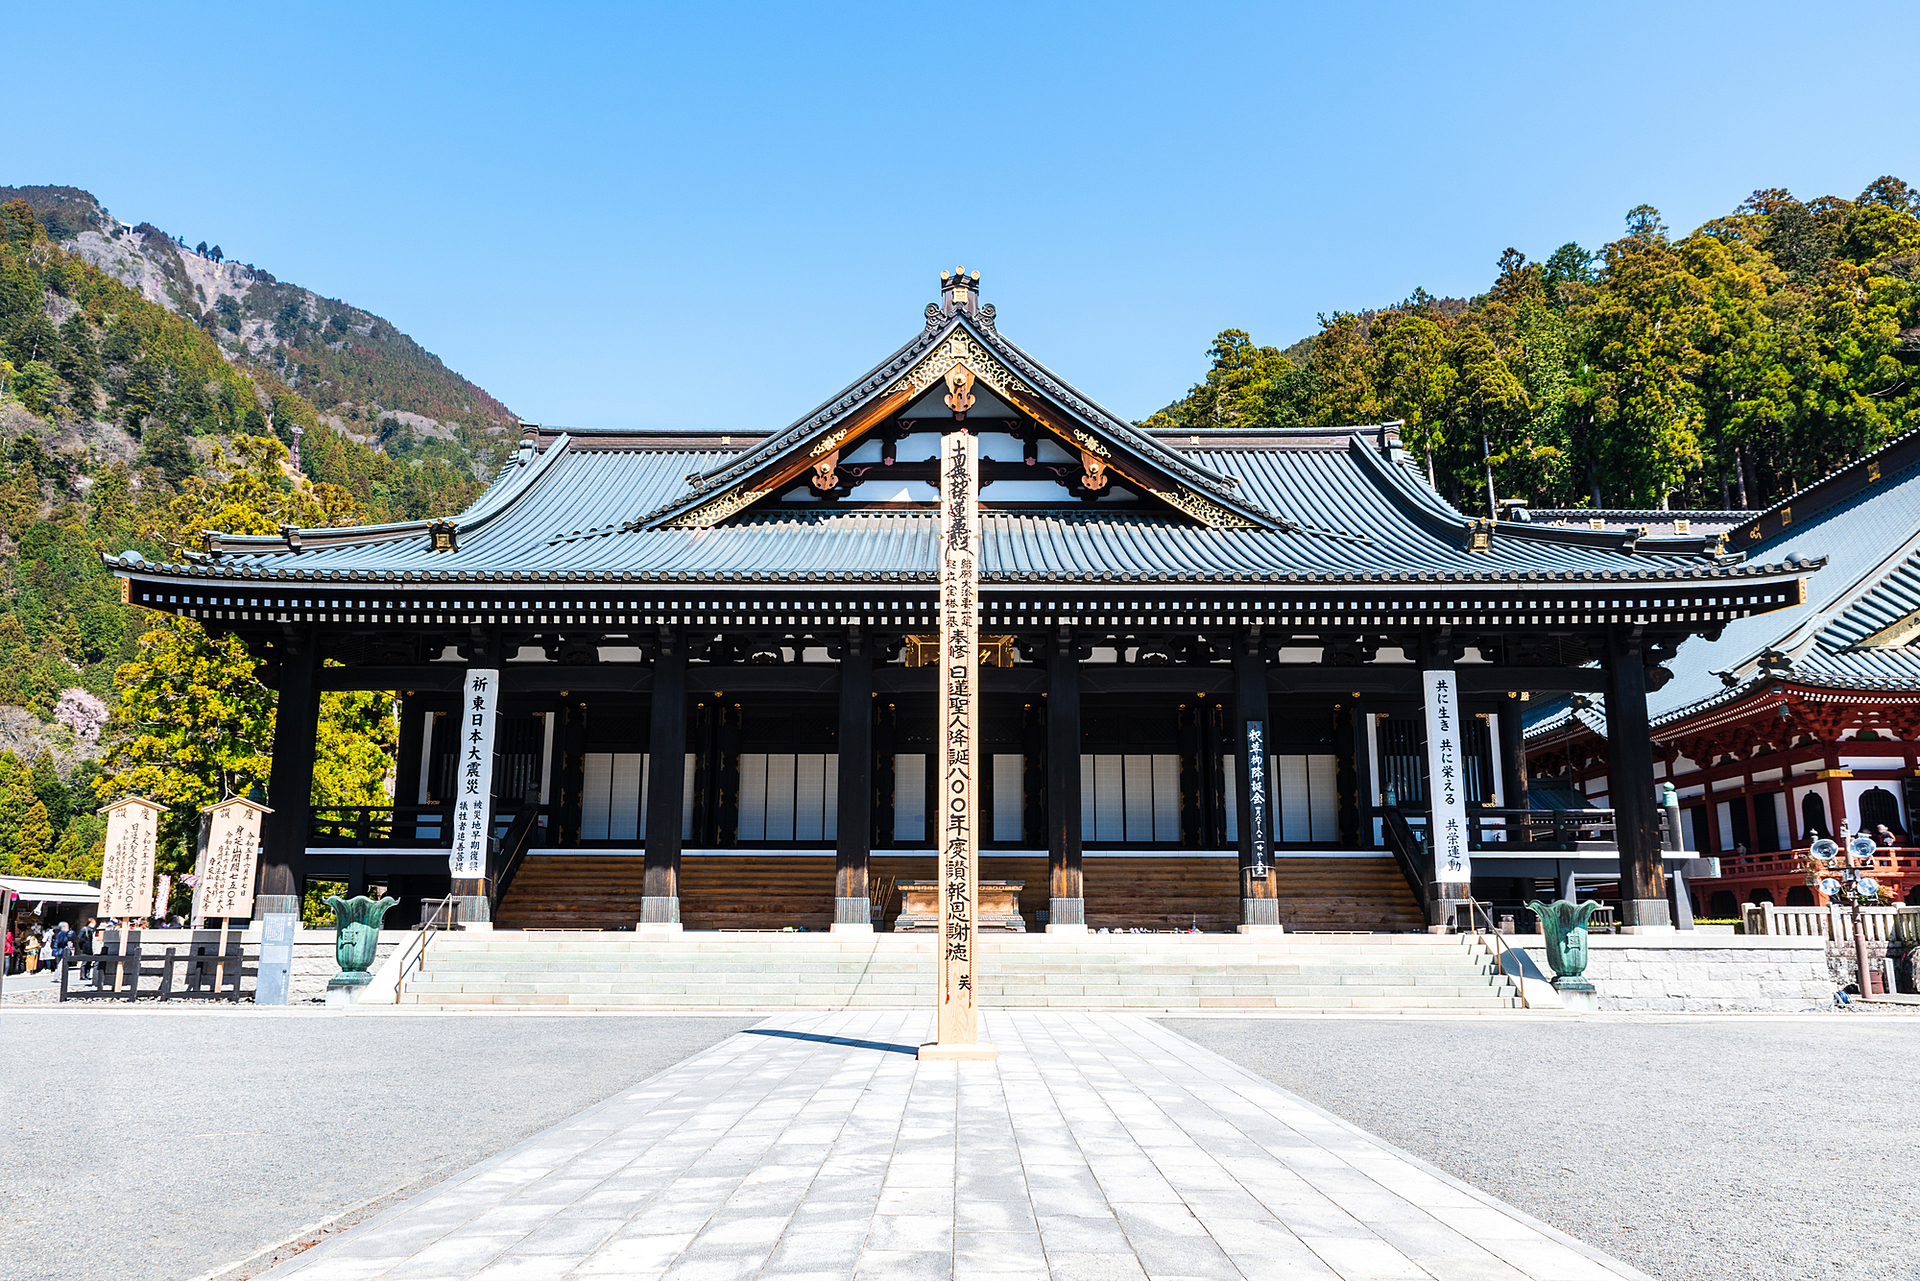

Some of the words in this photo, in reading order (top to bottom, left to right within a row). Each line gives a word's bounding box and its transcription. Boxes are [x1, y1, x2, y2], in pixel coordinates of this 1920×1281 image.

[1435, 679, 1450, 732] 共に生き
[1439, 738, 1456, 806] 共に栄える
[469, 799, 483, 873] 被災地早期復興
[1445, 818, 1462, 872] 共栄運動
